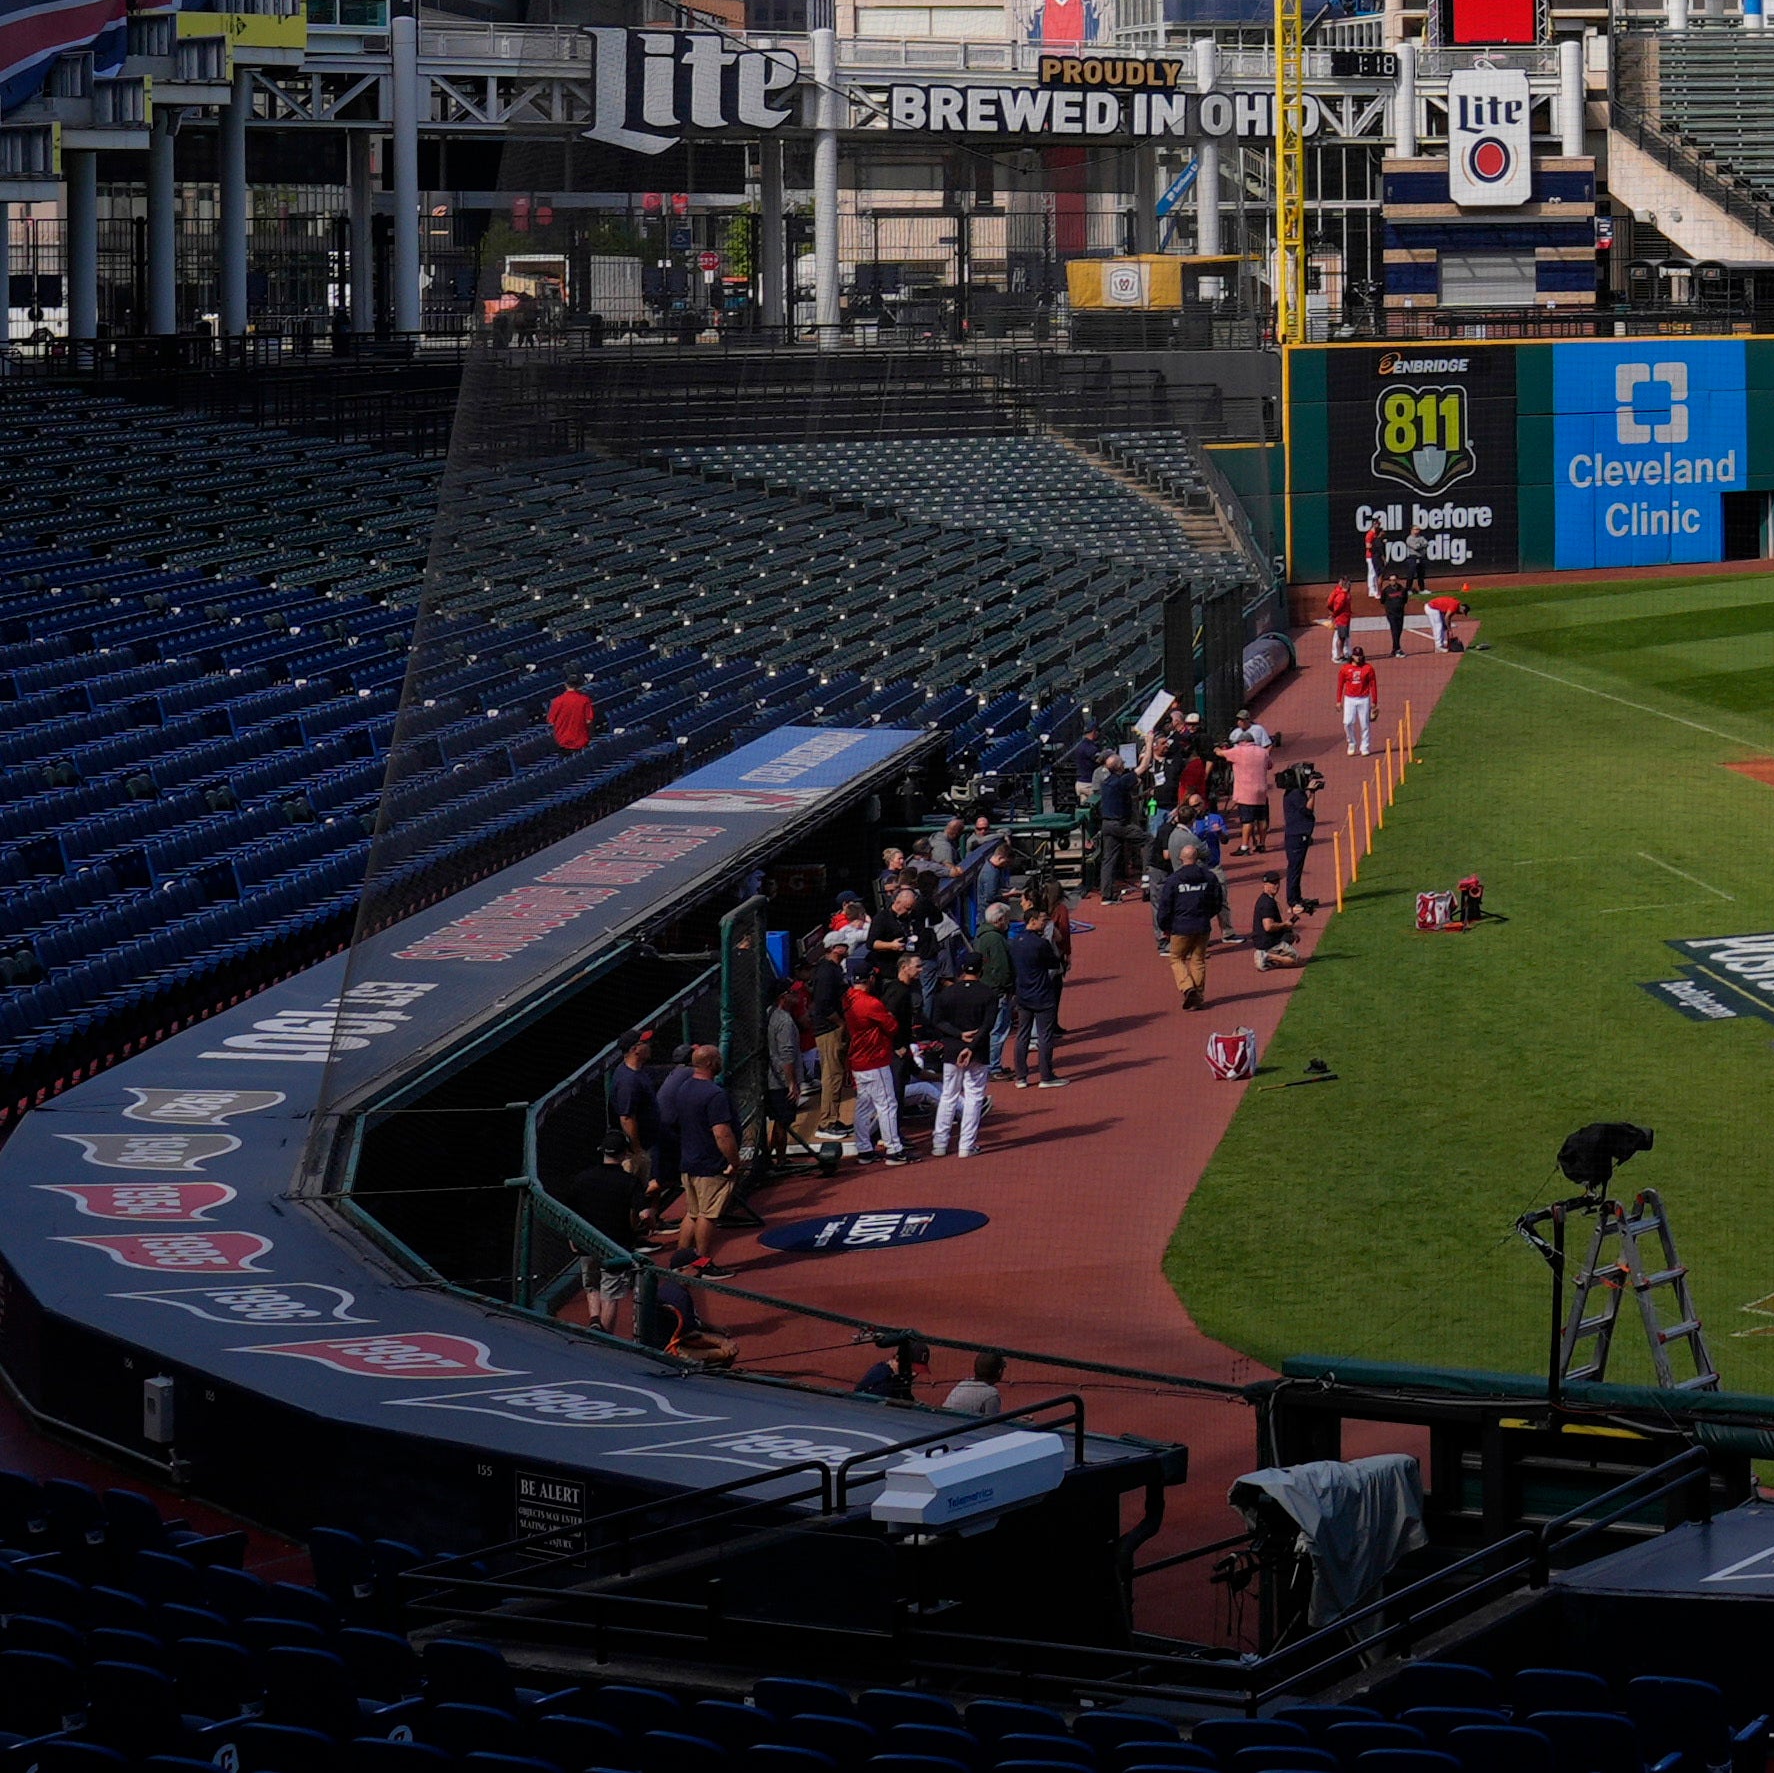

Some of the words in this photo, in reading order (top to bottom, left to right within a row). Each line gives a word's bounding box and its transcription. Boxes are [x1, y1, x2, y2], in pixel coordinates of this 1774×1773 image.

[1041, 58, 1182, 86] PROUDLY
[1357, 55, 1395, 75] 1:18
[582, 26, 800, 156] Lite
[891, 87, 1120, 134] BREWED
[1132, 92, 1186, 136] IN
[1456, 94, 1523, 134] Lite
[1393, 357, 1470, 375] ENBRIDGE
[1384, 392, 1460, 454] 811
[1568, 450, 1737, 488] Cleveland
[1355, 504, 1403, 532] Call
[1412, 502, 1493, 530] before
[1605, 501, 1701, 537] Clinic
[1426, 533, 1473, 566] dig.
[196, 1009, 414, 1063] 1901
[149, 1091, 241, 1119] 1920
[116, 1136, 191, 1164] 1948
[111, 1185, 183, 1216] 1954
[841, 1213, 904, 1245] ALDS
[139, 1235, 230, 1266] 1995
[204, 1288, 322, 1322] 1996
[328, 1336, 459, 1370] 1997
[489, 1388, 648, 1422] 1998
[519, 1478, 537, 1496] BE
[541, 1482, 581, 1506] ALERT
